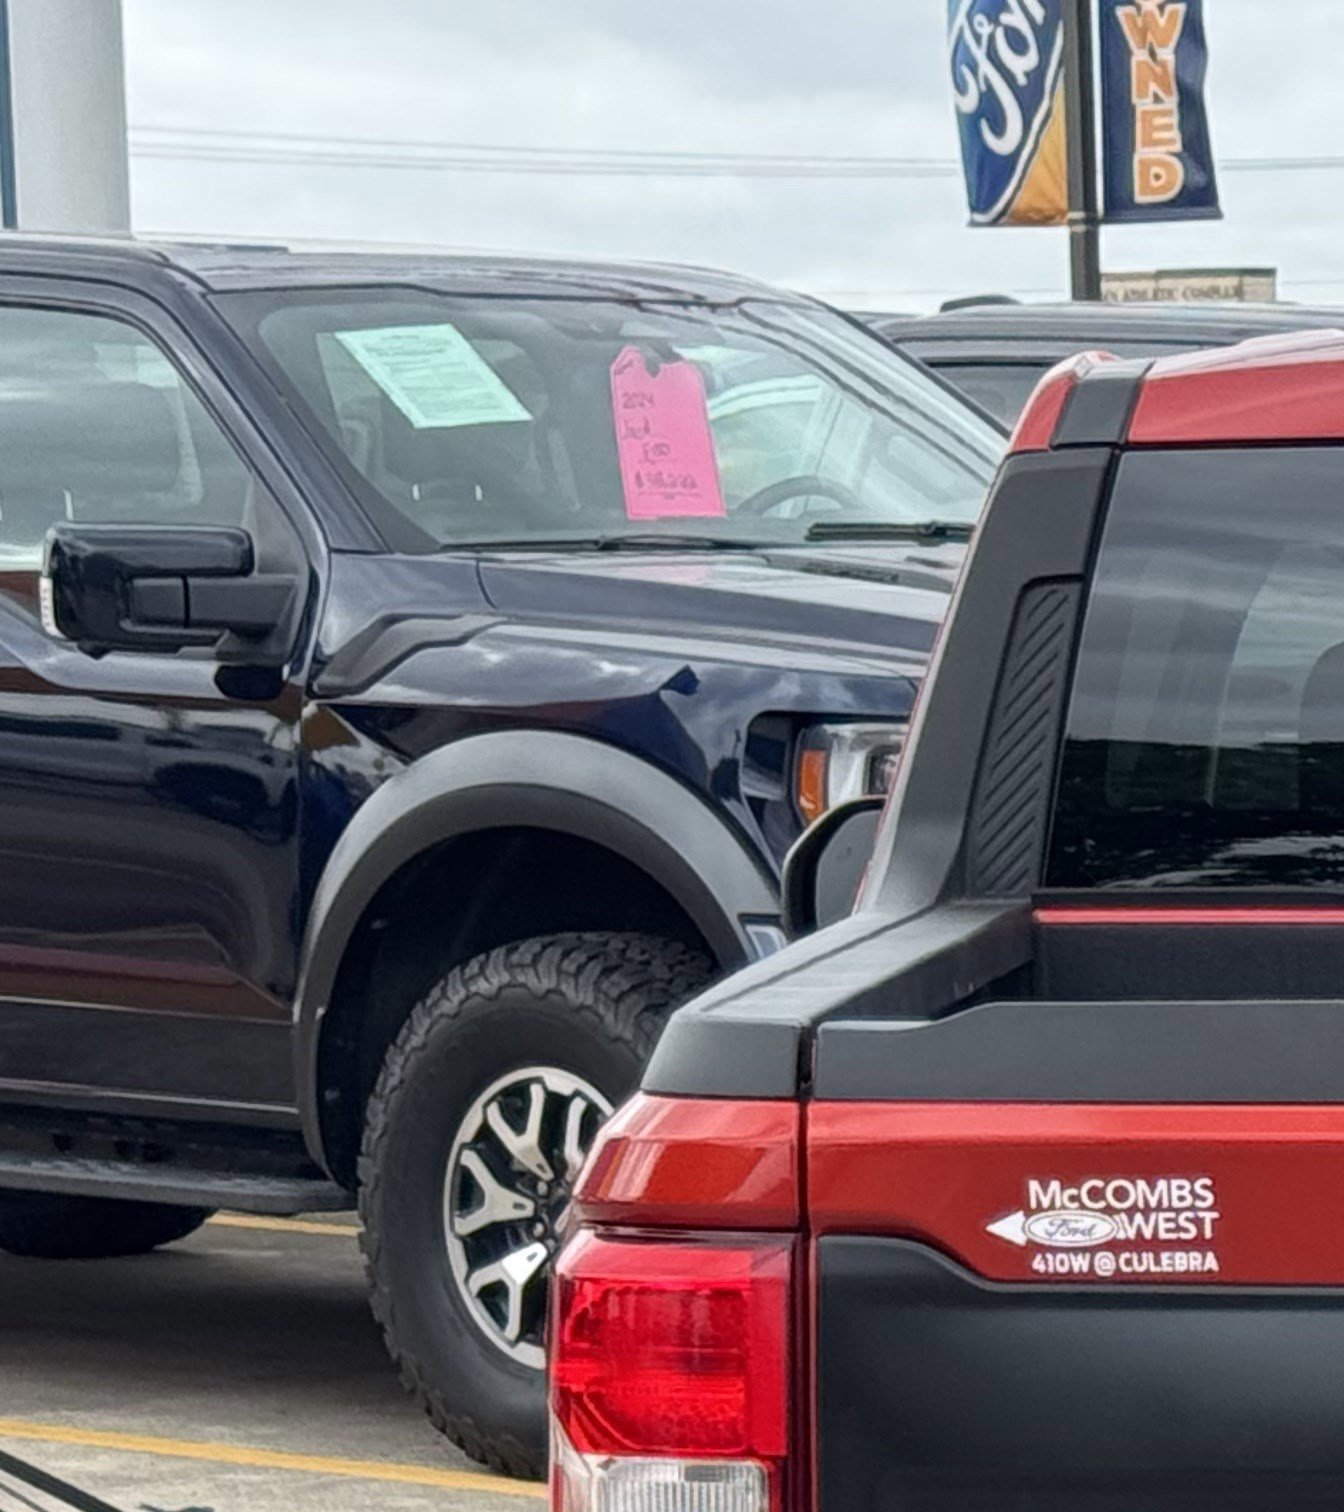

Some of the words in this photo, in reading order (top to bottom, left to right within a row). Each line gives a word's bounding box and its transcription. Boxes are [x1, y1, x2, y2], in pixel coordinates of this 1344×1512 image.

[1116, 0, 1187, 203] WNED
[1028, 1178, 1215, 1210] McCOMBS
[1043, 1218, 1097, 1238] Ford
[1118, 1211, 1220, 1240] WEST
[1031, 1252, 1090, 1273] 410W
[1119, 1251, 1220, 1273] CULEBRA
